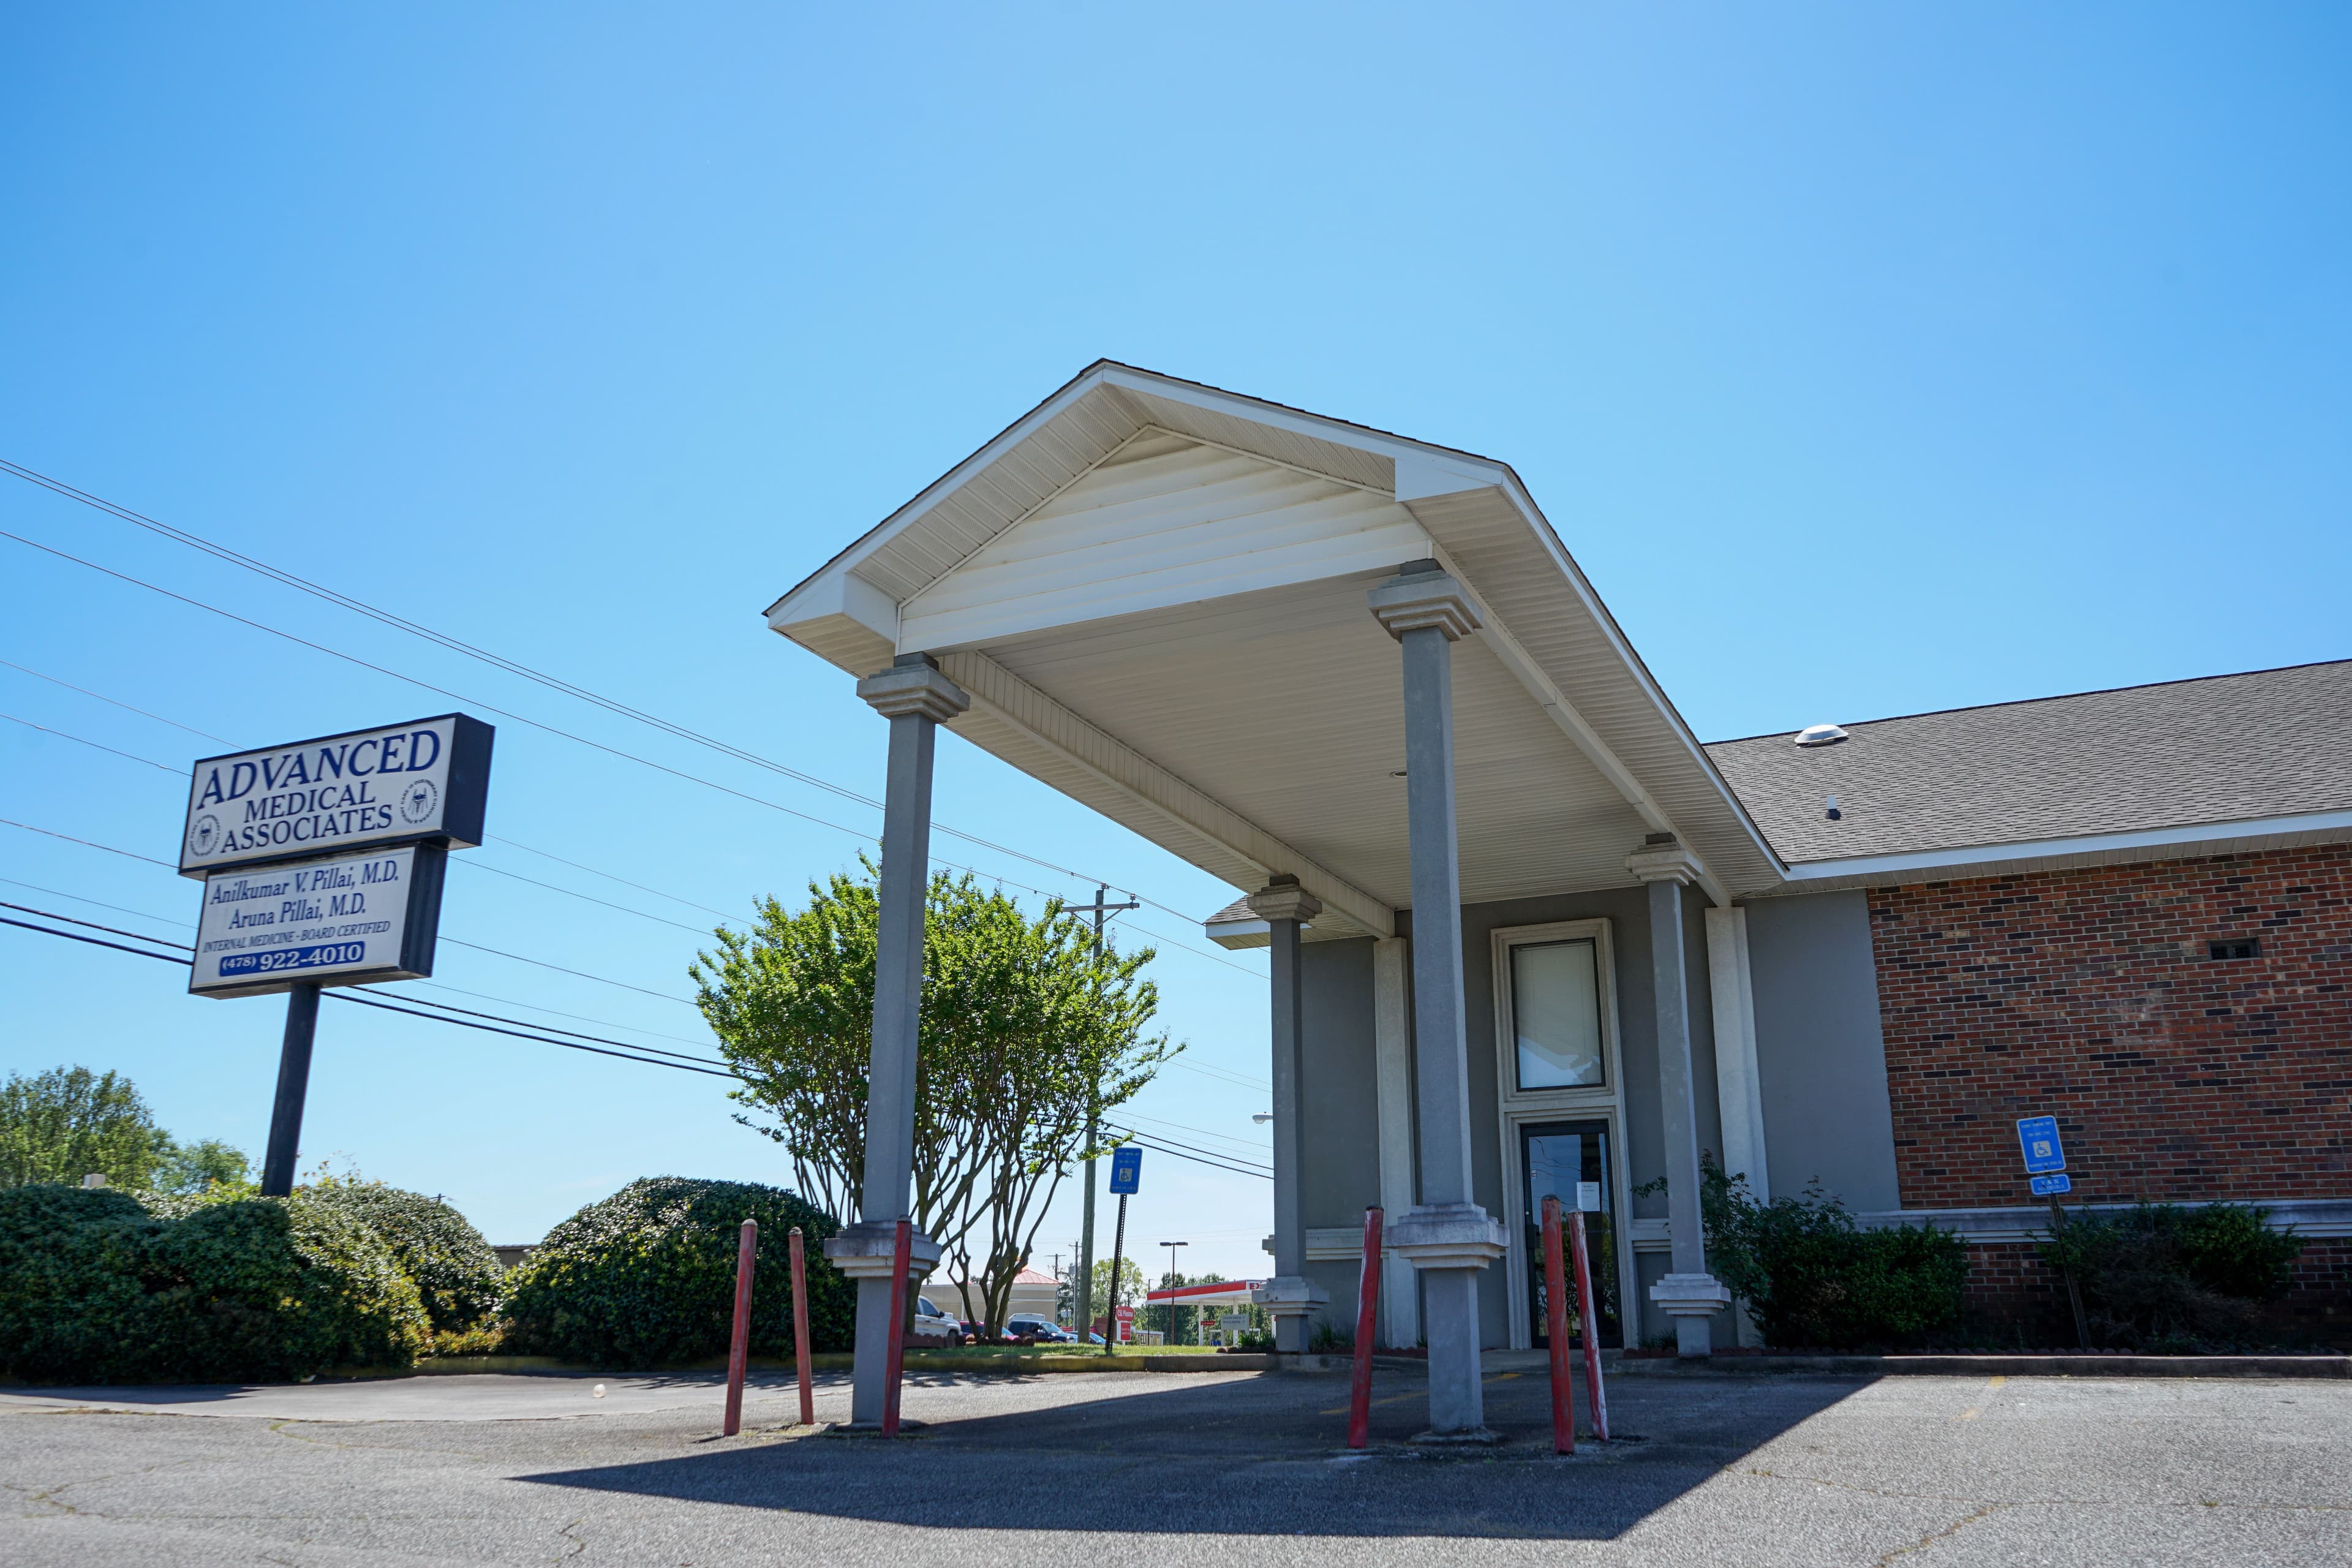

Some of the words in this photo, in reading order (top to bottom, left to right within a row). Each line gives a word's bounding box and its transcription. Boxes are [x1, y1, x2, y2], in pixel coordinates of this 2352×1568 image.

[196, 730, 440, 810] ADVANCED
[243, 780, 377, 823] MEDICAL
[220, 804, 393, 853] ASSOCIATES
[209, 880, 290, 905] Anilkumar
[295, 872, 309, 892] V.
[311, 866, 355, 891] Pillai,
[360, 860, 399, 884] M.D.
[228, 908, 275, 929] Aruna
[279, 898, 323, 922] Pillai,
[328, 892, 366, 917] M.D.
[203, 937, 247, 952] INTERNAL
[247, 931, 296, 947] MEDICINE
[300, 926, 336, 941] BOARD
[337, 921, 391, 937] CERTIFIED
[222, 956, 257, 970] (478)
[260, 944, 363, 970] 922-4010
